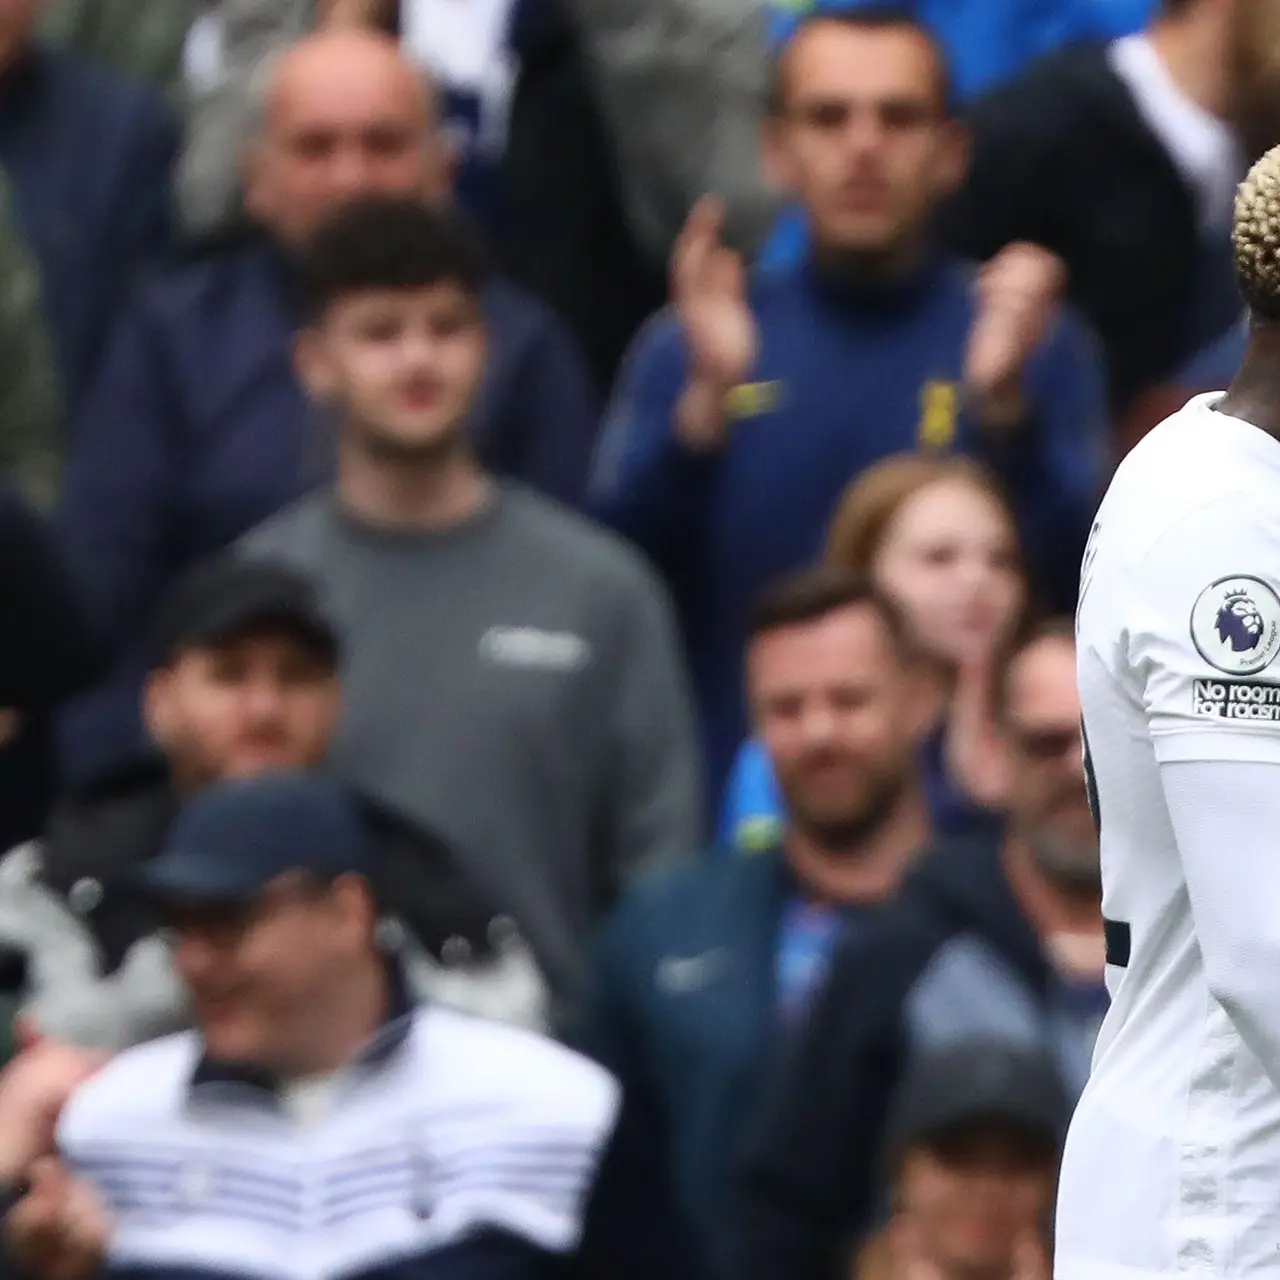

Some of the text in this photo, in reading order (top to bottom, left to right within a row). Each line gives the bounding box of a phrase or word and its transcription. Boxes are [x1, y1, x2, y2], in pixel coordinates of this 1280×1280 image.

[1193, 680, 1280, 702] No room
[1193, 698, 1224, 716] for
